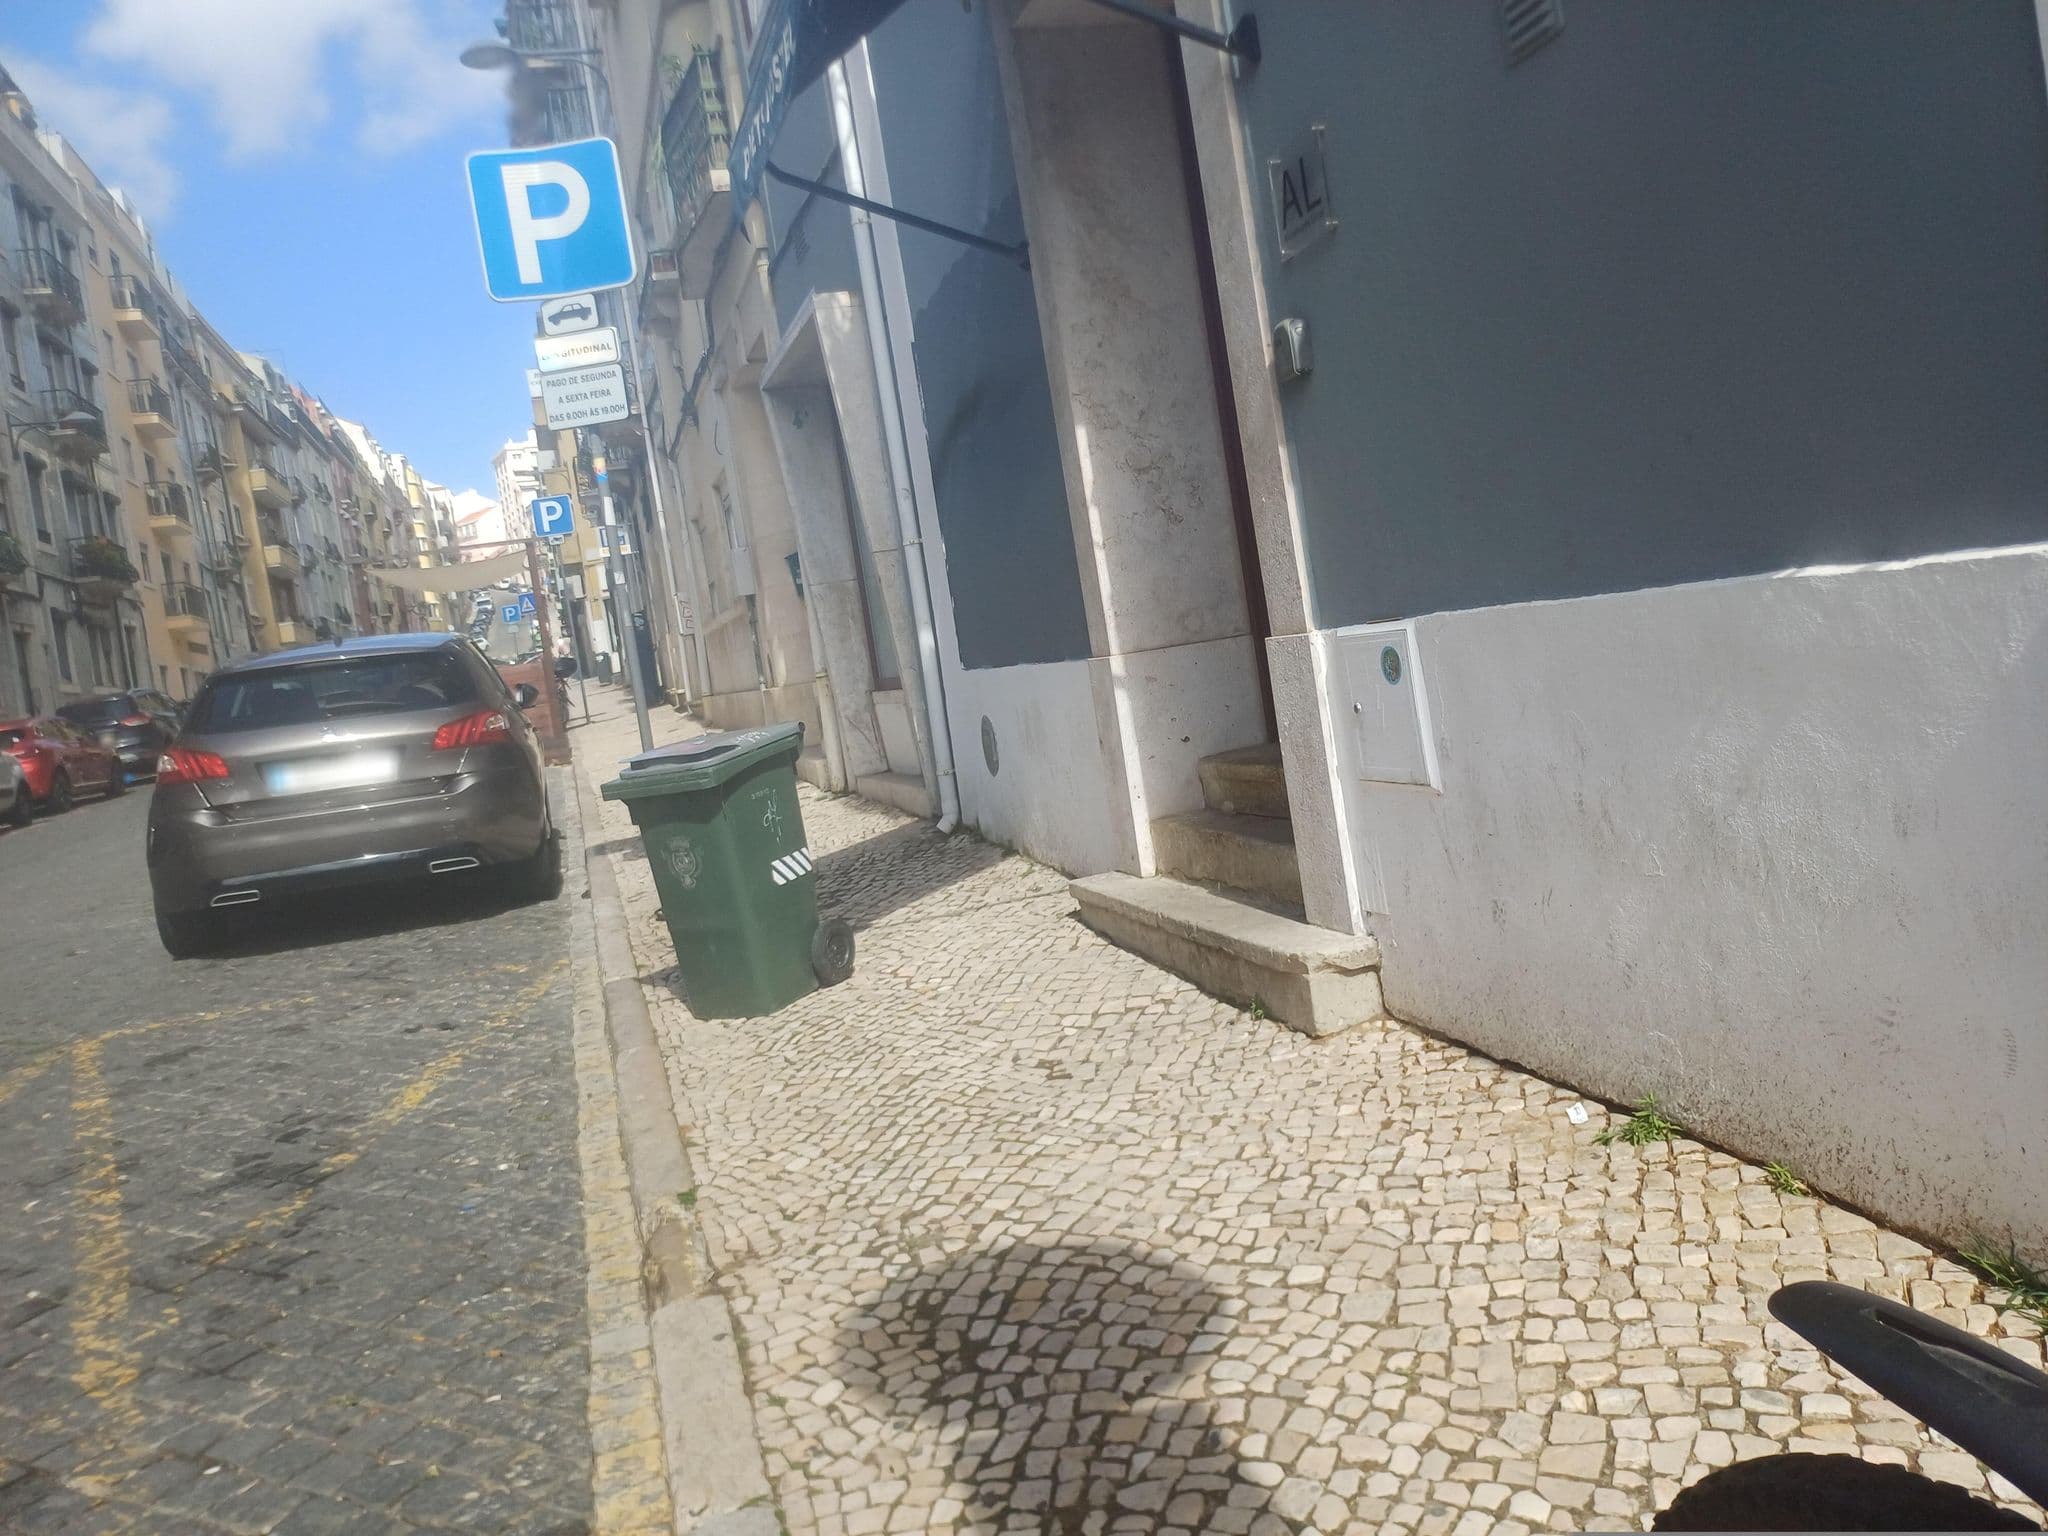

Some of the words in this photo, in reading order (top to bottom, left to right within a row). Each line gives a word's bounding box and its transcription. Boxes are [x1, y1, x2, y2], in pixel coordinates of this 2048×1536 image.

[1282, 156, 1322, 231] AL
[500, 160, 591, 285] P
[546, 378, 566, 388] PAGO
[569, 376, 578, 385] DE
[581, 371, 617, 383] SEGUNDA
[565, 394, 589, 403] SEXTA
[590, 388, 612, 400] FEIRA
[549, 414, 565, 424] DAS
[539, 501, 563, 533] P
[505, 607, 516, 622] P
